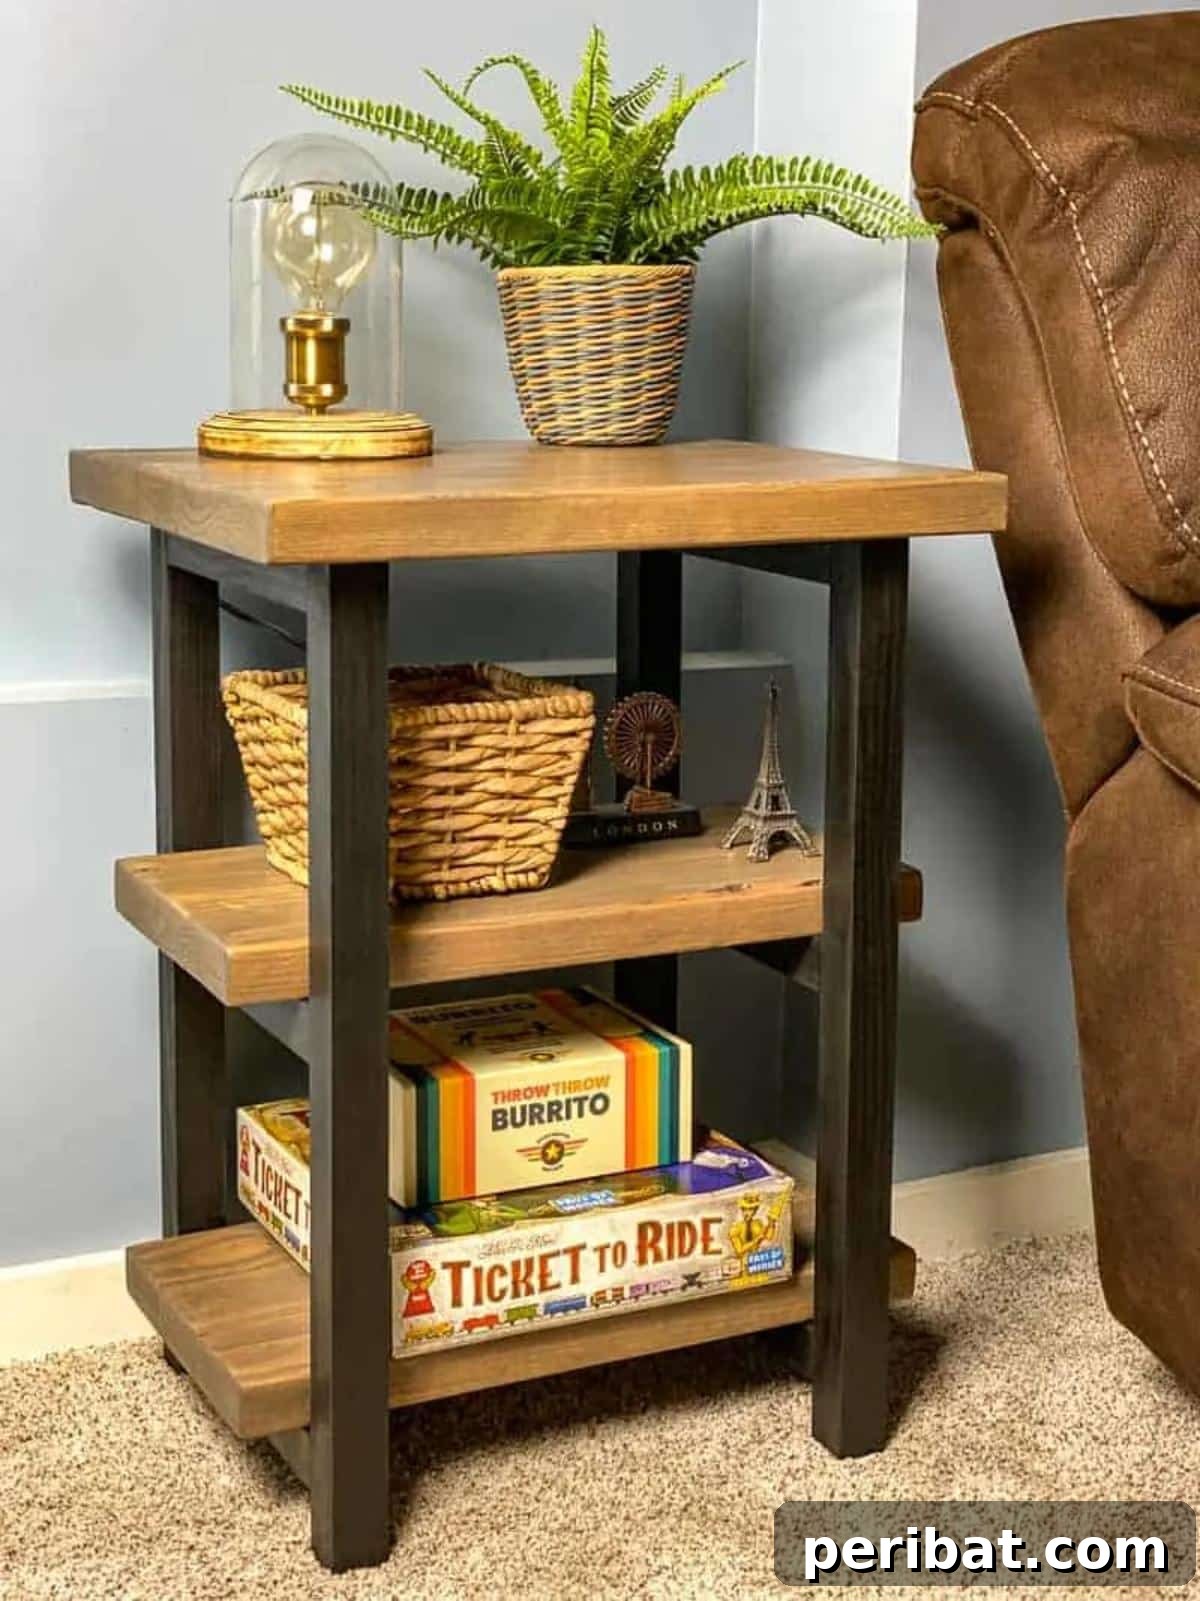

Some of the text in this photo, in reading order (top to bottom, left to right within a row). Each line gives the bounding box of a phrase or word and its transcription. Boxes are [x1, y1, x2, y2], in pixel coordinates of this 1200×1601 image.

[592, 820, 679, 840] LONDON
[491, 1074, 610, 1104] THROW THROW
[491, 1091, 610, 1132] BURRITO
[252, 1139, 302, 1225] TICKET
[441, 1243, 587, 1308] TICKET
[593, 1240, 628, 1274] TO
[636, 1217, 724, 1267] RIDE
